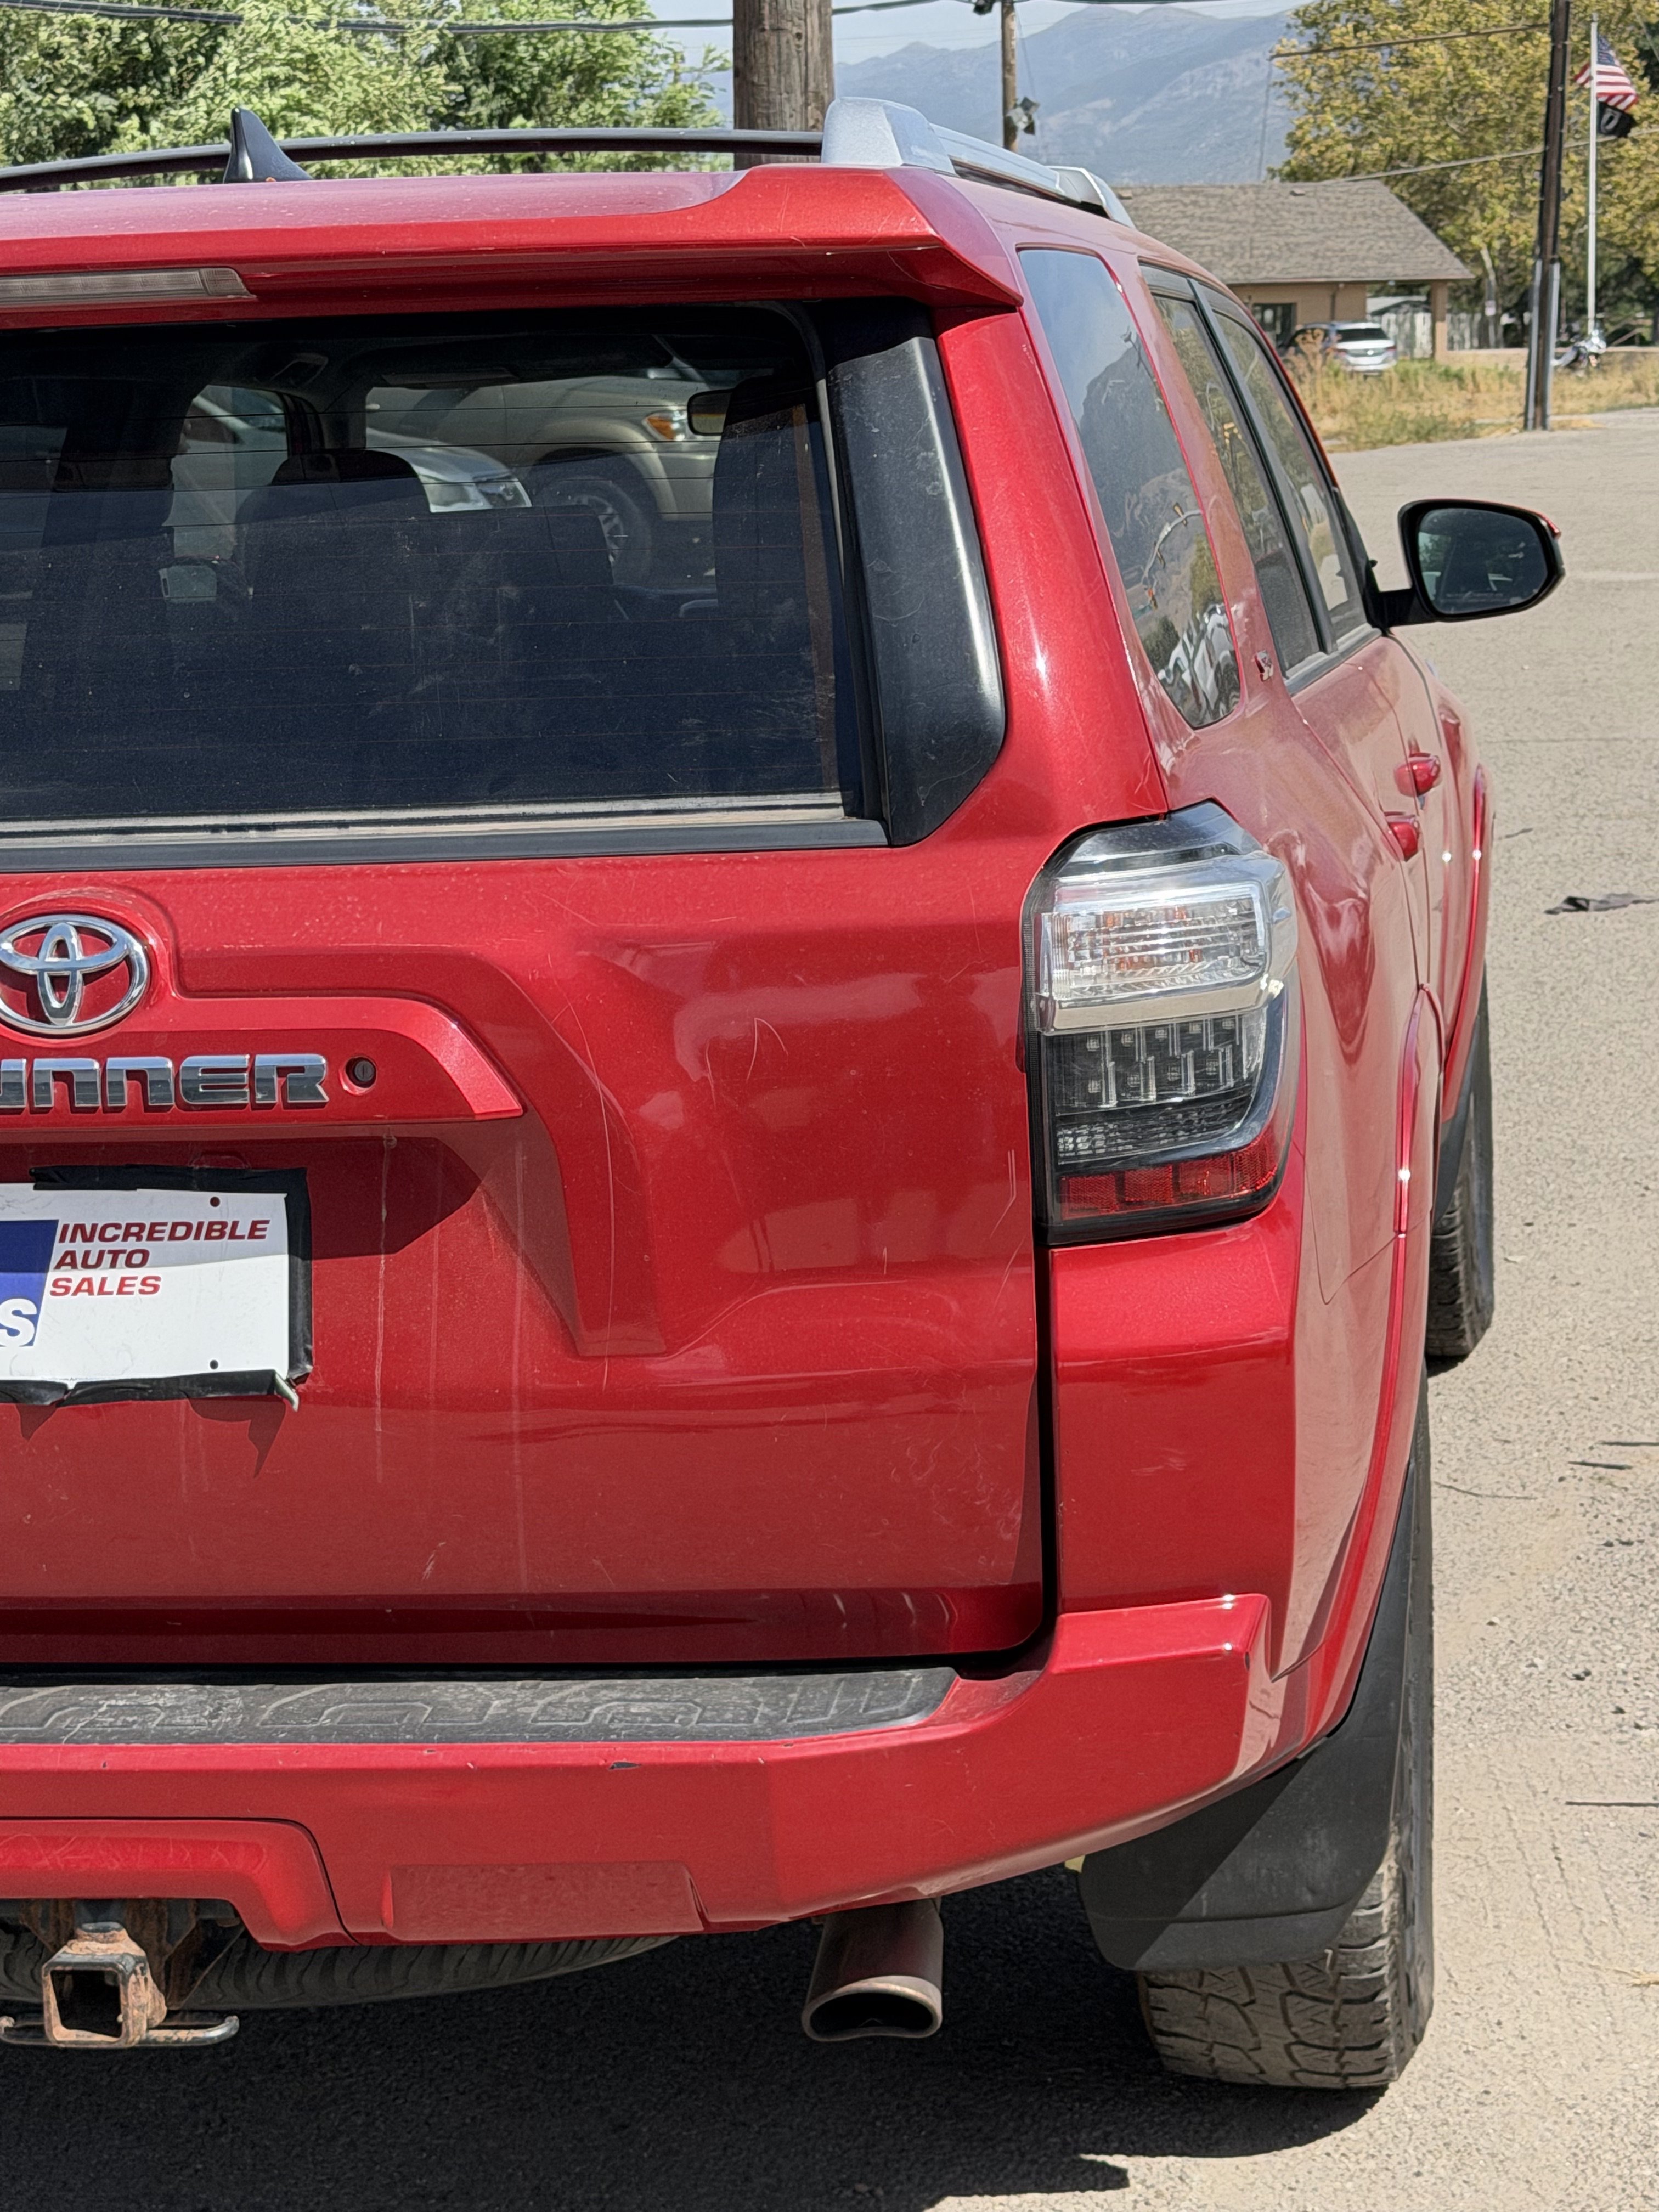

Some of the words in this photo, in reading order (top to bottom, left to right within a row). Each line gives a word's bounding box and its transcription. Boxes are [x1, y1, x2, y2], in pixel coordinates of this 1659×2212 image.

[58, 1220, 270, 1243] INCREDIBLE
[53, 1249, 150, 1270] AUTO
[49, 1276, 162, 1296] SALES
